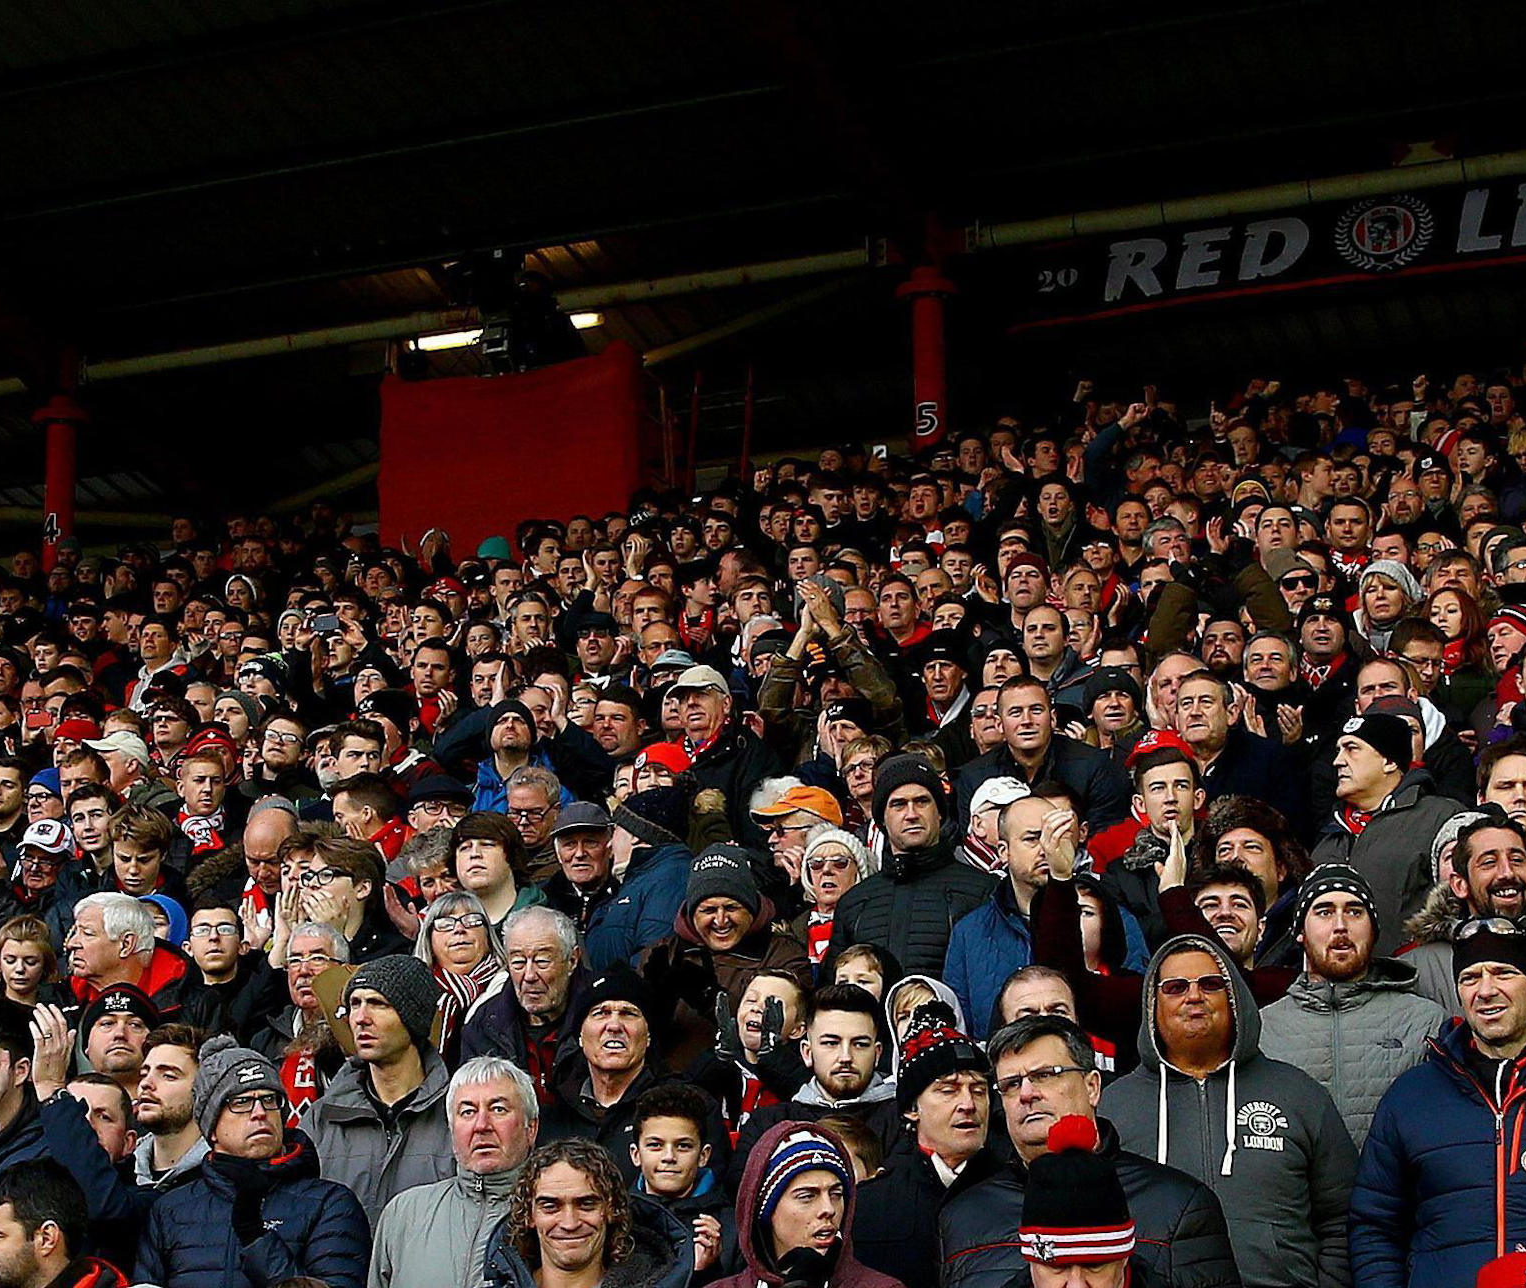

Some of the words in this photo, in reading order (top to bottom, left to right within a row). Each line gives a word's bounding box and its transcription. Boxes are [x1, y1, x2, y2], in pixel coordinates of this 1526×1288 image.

[1037, 268, 1079, 293] 20
[1104, 216, 1310, 302] RED
[915, 401, 938, 436] 5
[43, 512, 61, 545] 4
[1236, 1101, 1283, 1126] UNIVERSITY
[1242, 1135, 1284, 1151] LONDON
